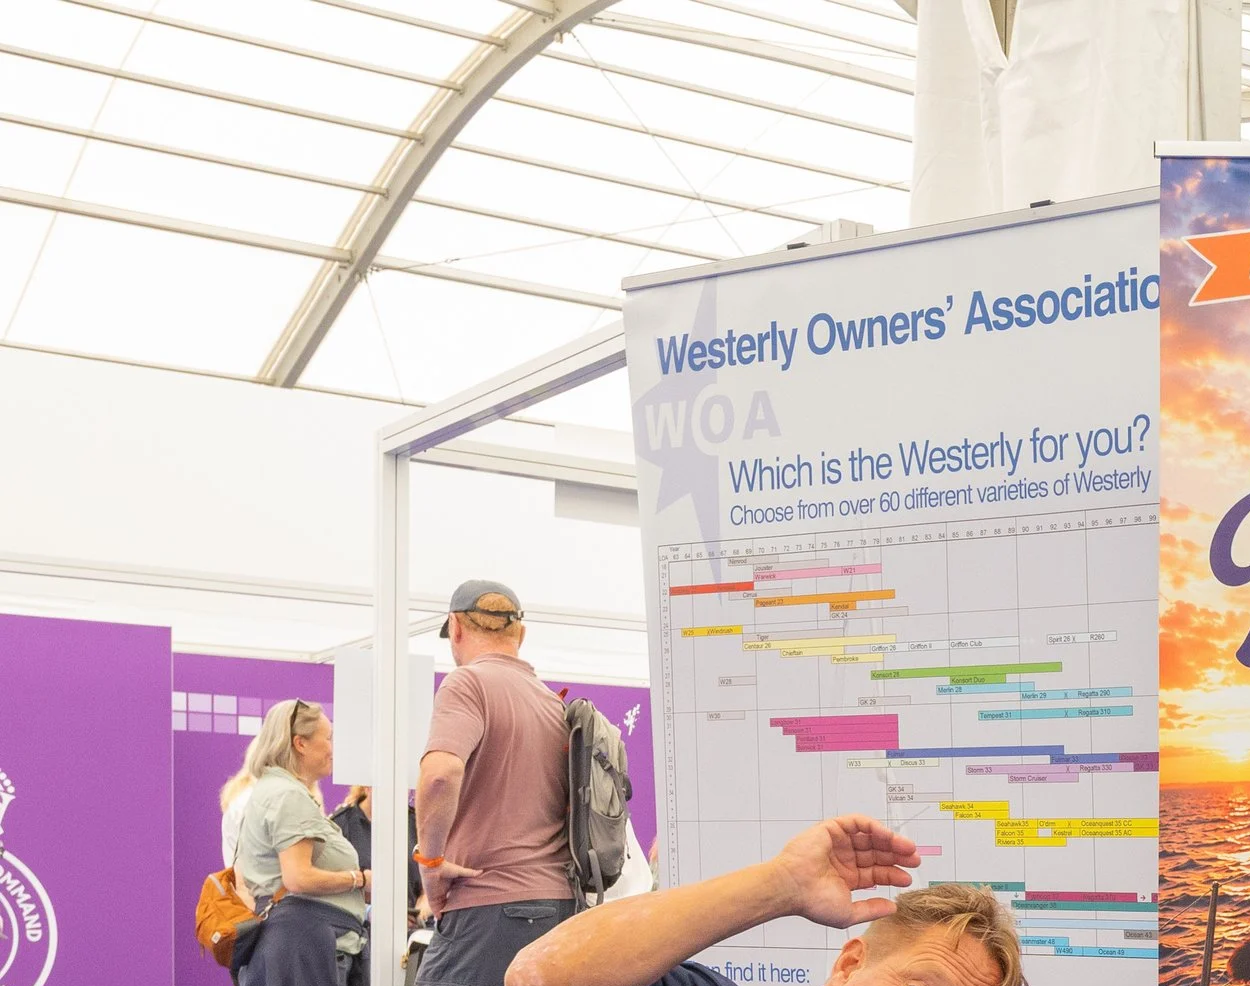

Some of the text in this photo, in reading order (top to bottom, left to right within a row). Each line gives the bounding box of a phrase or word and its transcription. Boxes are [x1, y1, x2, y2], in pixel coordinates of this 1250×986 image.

[657, 321, 798, 375] Westerly
[964, 266, 1159, 336] Associatio
[729, 413, 1151, 493] Which is the Westerly for you?
[730, 465, 1152, 526] Choose from over 60 different varieties of Westerly
[757, 634, 769, 642] Tiger
[0, 864, 43, 942] MMAND
[725, 962, 754, 982] find
[758, 963, 767, 982] it
[770, 963, 810, 984] here:
